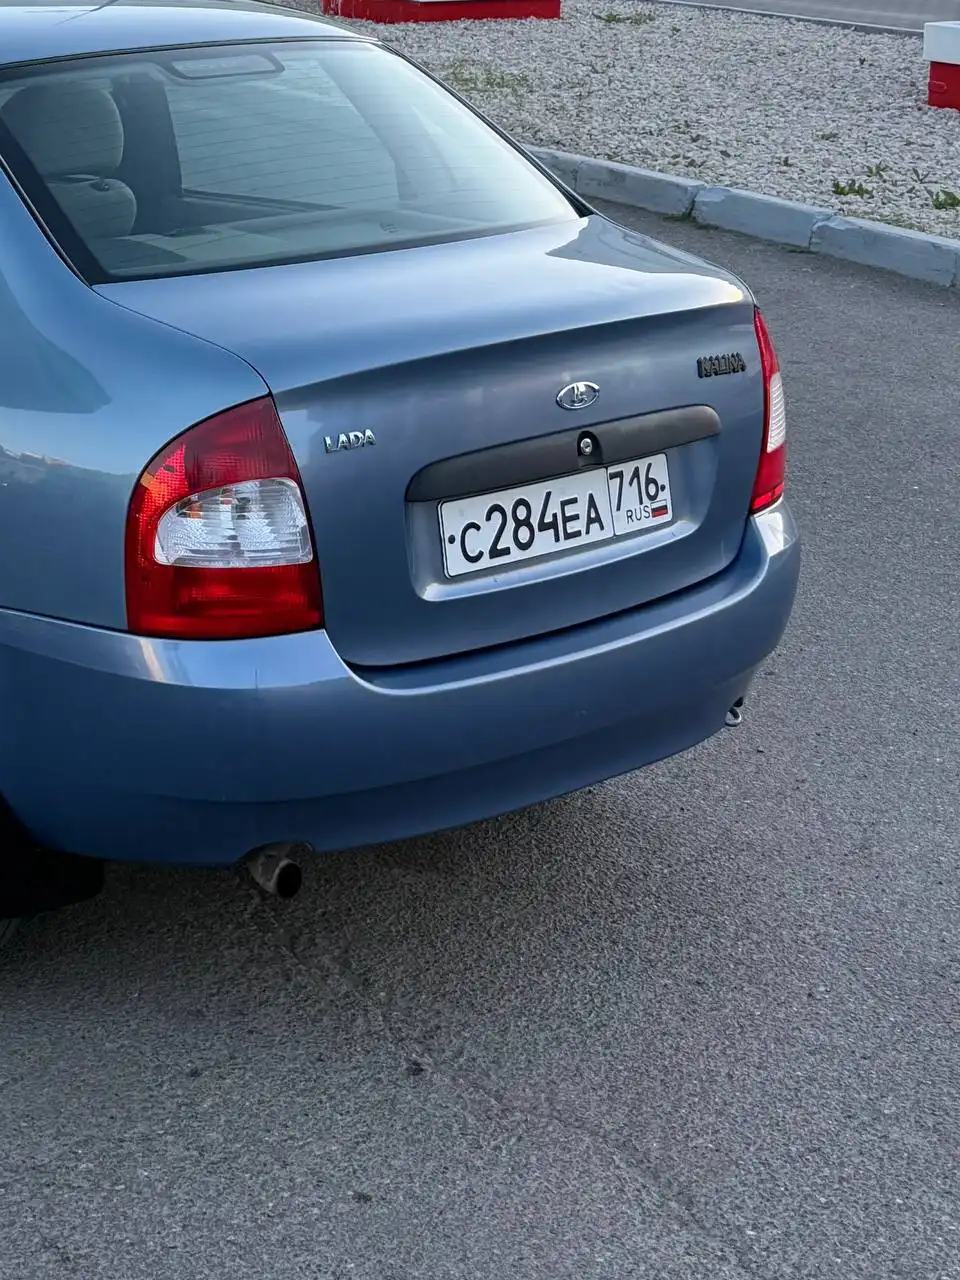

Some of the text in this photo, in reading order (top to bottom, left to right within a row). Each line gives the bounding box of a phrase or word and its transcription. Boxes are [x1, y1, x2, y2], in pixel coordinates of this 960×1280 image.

[323, 428, 376, 453] LADA
[608, 462, 660, 512] 716
[625, 504, 651, 524] RUS
